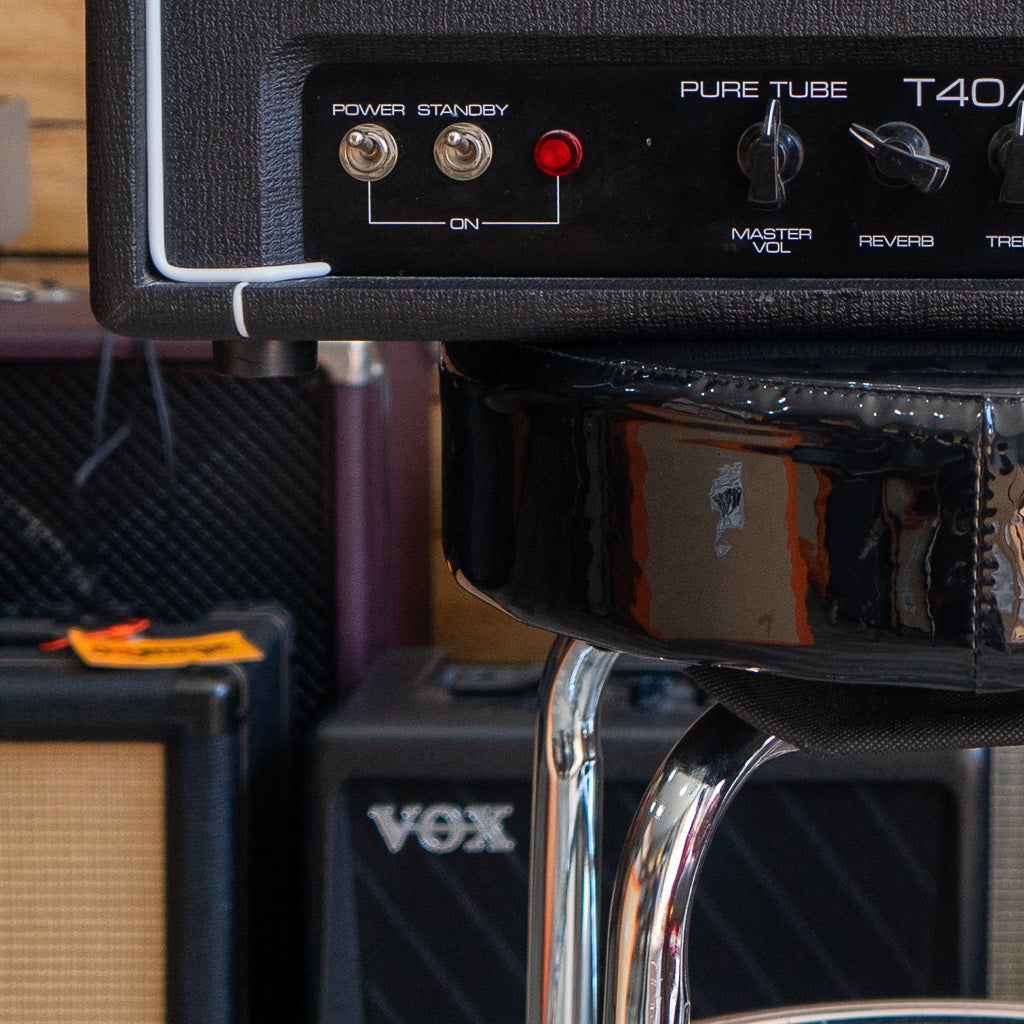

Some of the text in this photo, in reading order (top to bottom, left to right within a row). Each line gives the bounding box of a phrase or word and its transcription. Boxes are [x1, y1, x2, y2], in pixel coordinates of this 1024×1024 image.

[680, 80, 848, 98] PURE TUBE
[332, 103, 406, 116] POWER
[417, 103, 509, 117] STANDBY
[449, 217, 479, 230] ON
[731, 227, 812, 240] MASTER
[752, 241, 791, 254] VOL
[859, 234, 935, 248] REVERB
[367, 803, 515, 854] VOX
